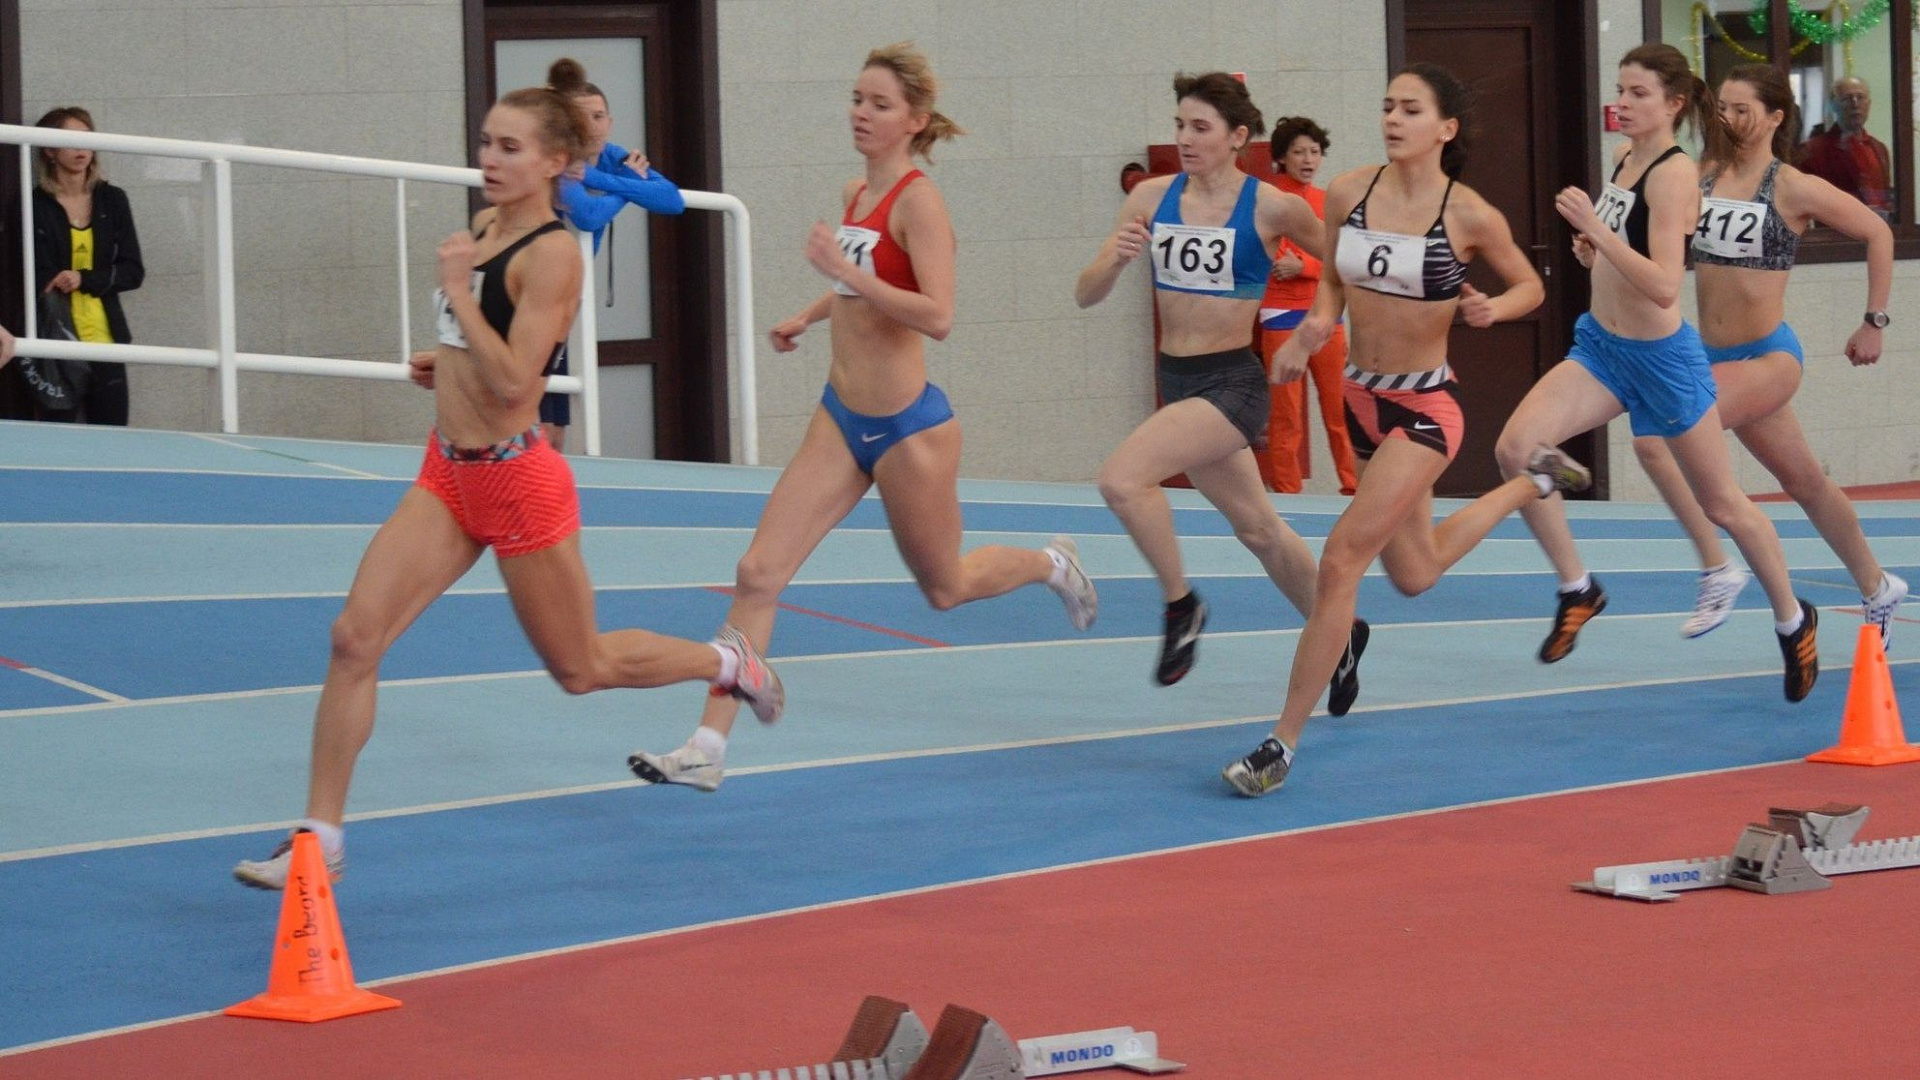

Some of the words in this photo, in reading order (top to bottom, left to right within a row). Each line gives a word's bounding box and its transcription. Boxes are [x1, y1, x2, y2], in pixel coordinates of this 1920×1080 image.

[1695, 207, 1759, 244] 412
[1158, 235, 1227, 274] 163
[1367, 244, 1393, 278] 6
[1649, 870, 1700, 885] MONDO
[297, 947, 326, 984] The
[1050, 1044, 1115, 1066] MONDO
